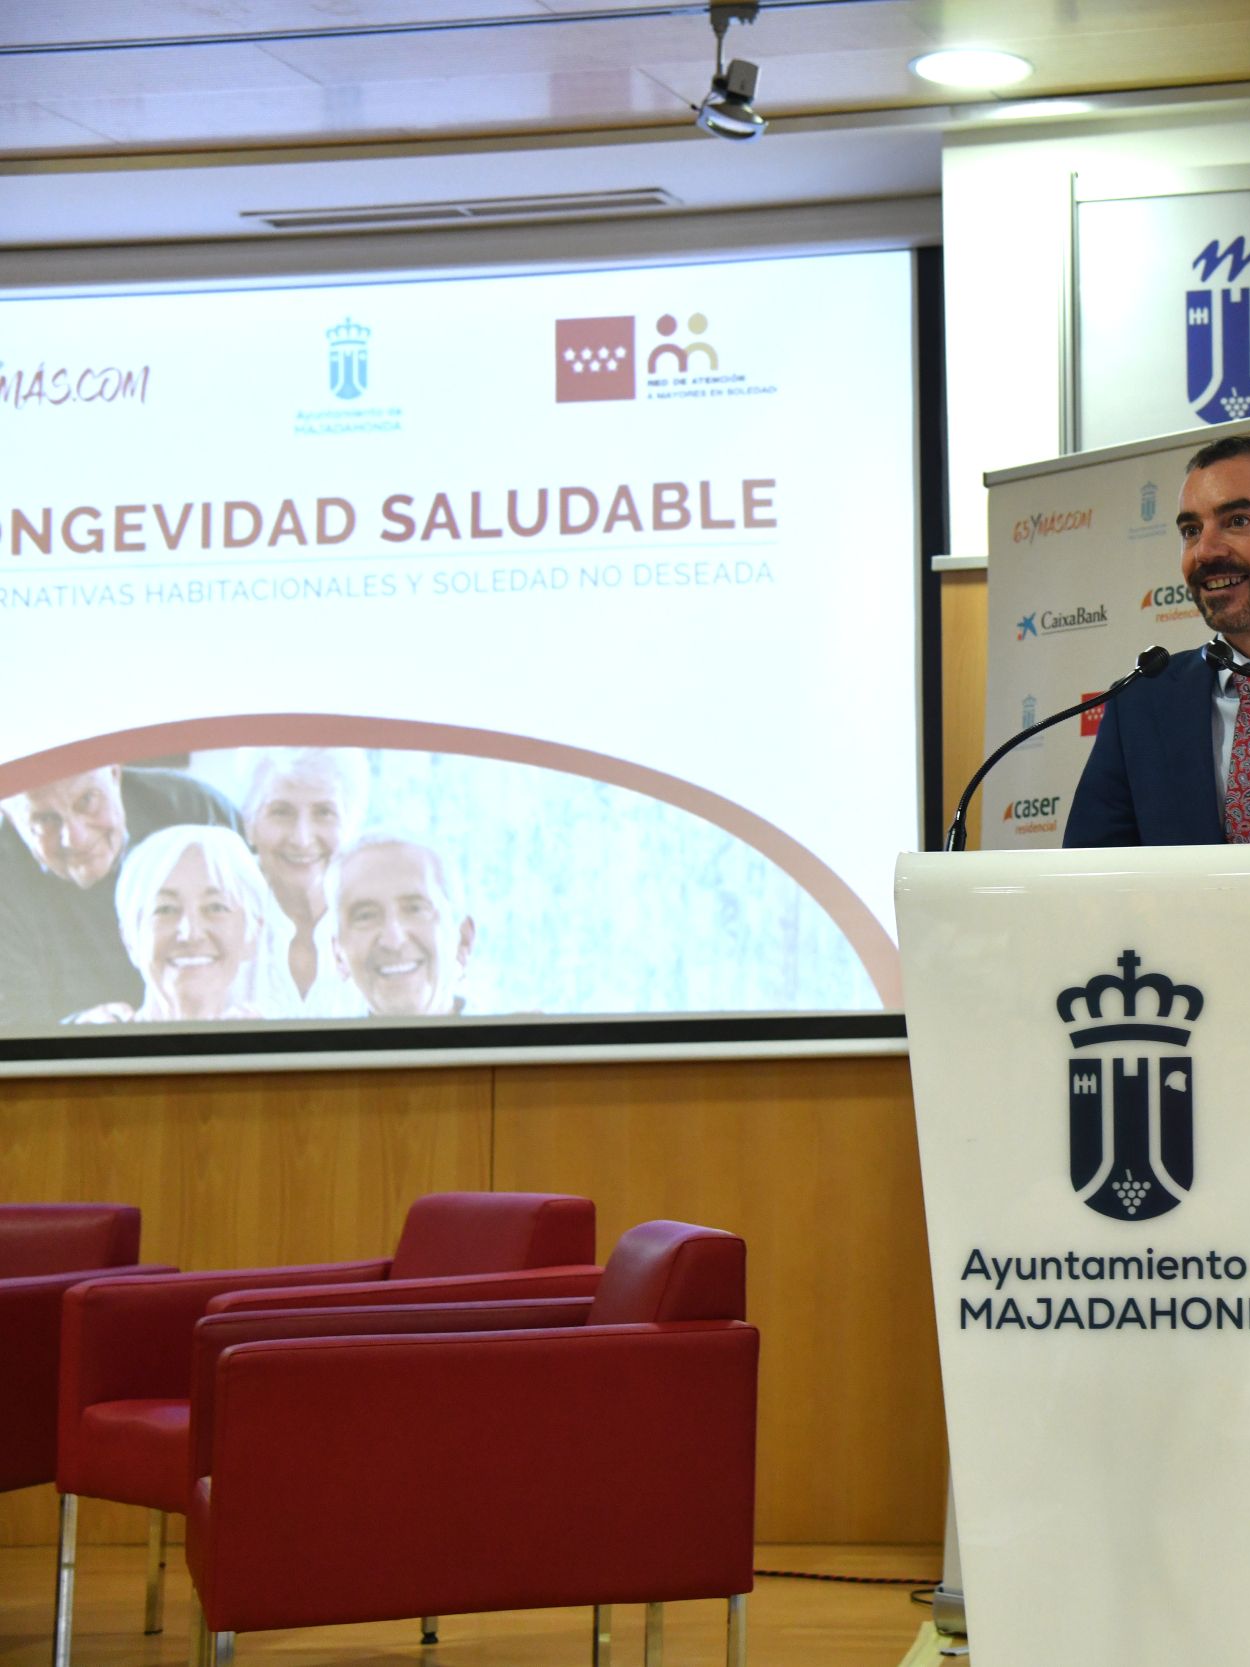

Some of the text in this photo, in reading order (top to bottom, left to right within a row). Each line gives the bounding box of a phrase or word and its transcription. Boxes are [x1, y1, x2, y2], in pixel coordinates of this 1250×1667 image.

[0, 478, 778, 556] NGEVIDAD SALUDABLE
[146, 573, 397, 603] HABITACIONALES
[406, 573, 424, 595] Y
[433, 566, 569, 595] SOLEDAD
[580, 564, 622, 589] NO
[633, 561, 775, 587] DESEADA
[1153, 584, 1194, 607] case
[1041, 604, 1108, 630] CaixaBank
[1014, 796, 1061, 819] caser
[960, 1248, 1247, 1290] Ayuntamiento
